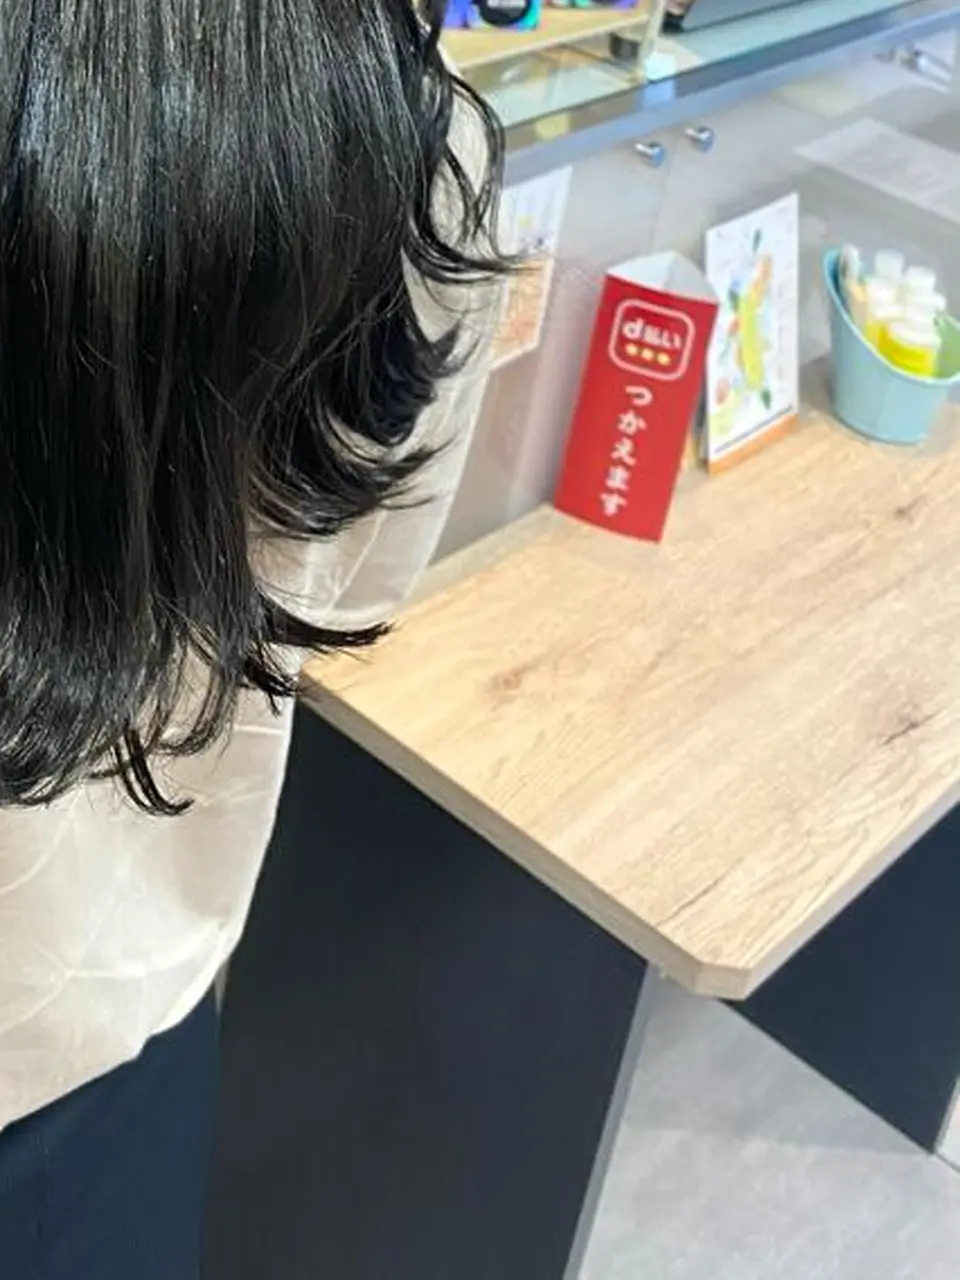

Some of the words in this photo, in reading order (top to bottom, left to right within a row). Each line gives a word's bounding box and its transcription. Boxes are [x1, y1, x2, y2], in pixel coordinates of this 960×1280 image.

[600, 385, 653, 517] つかえます
